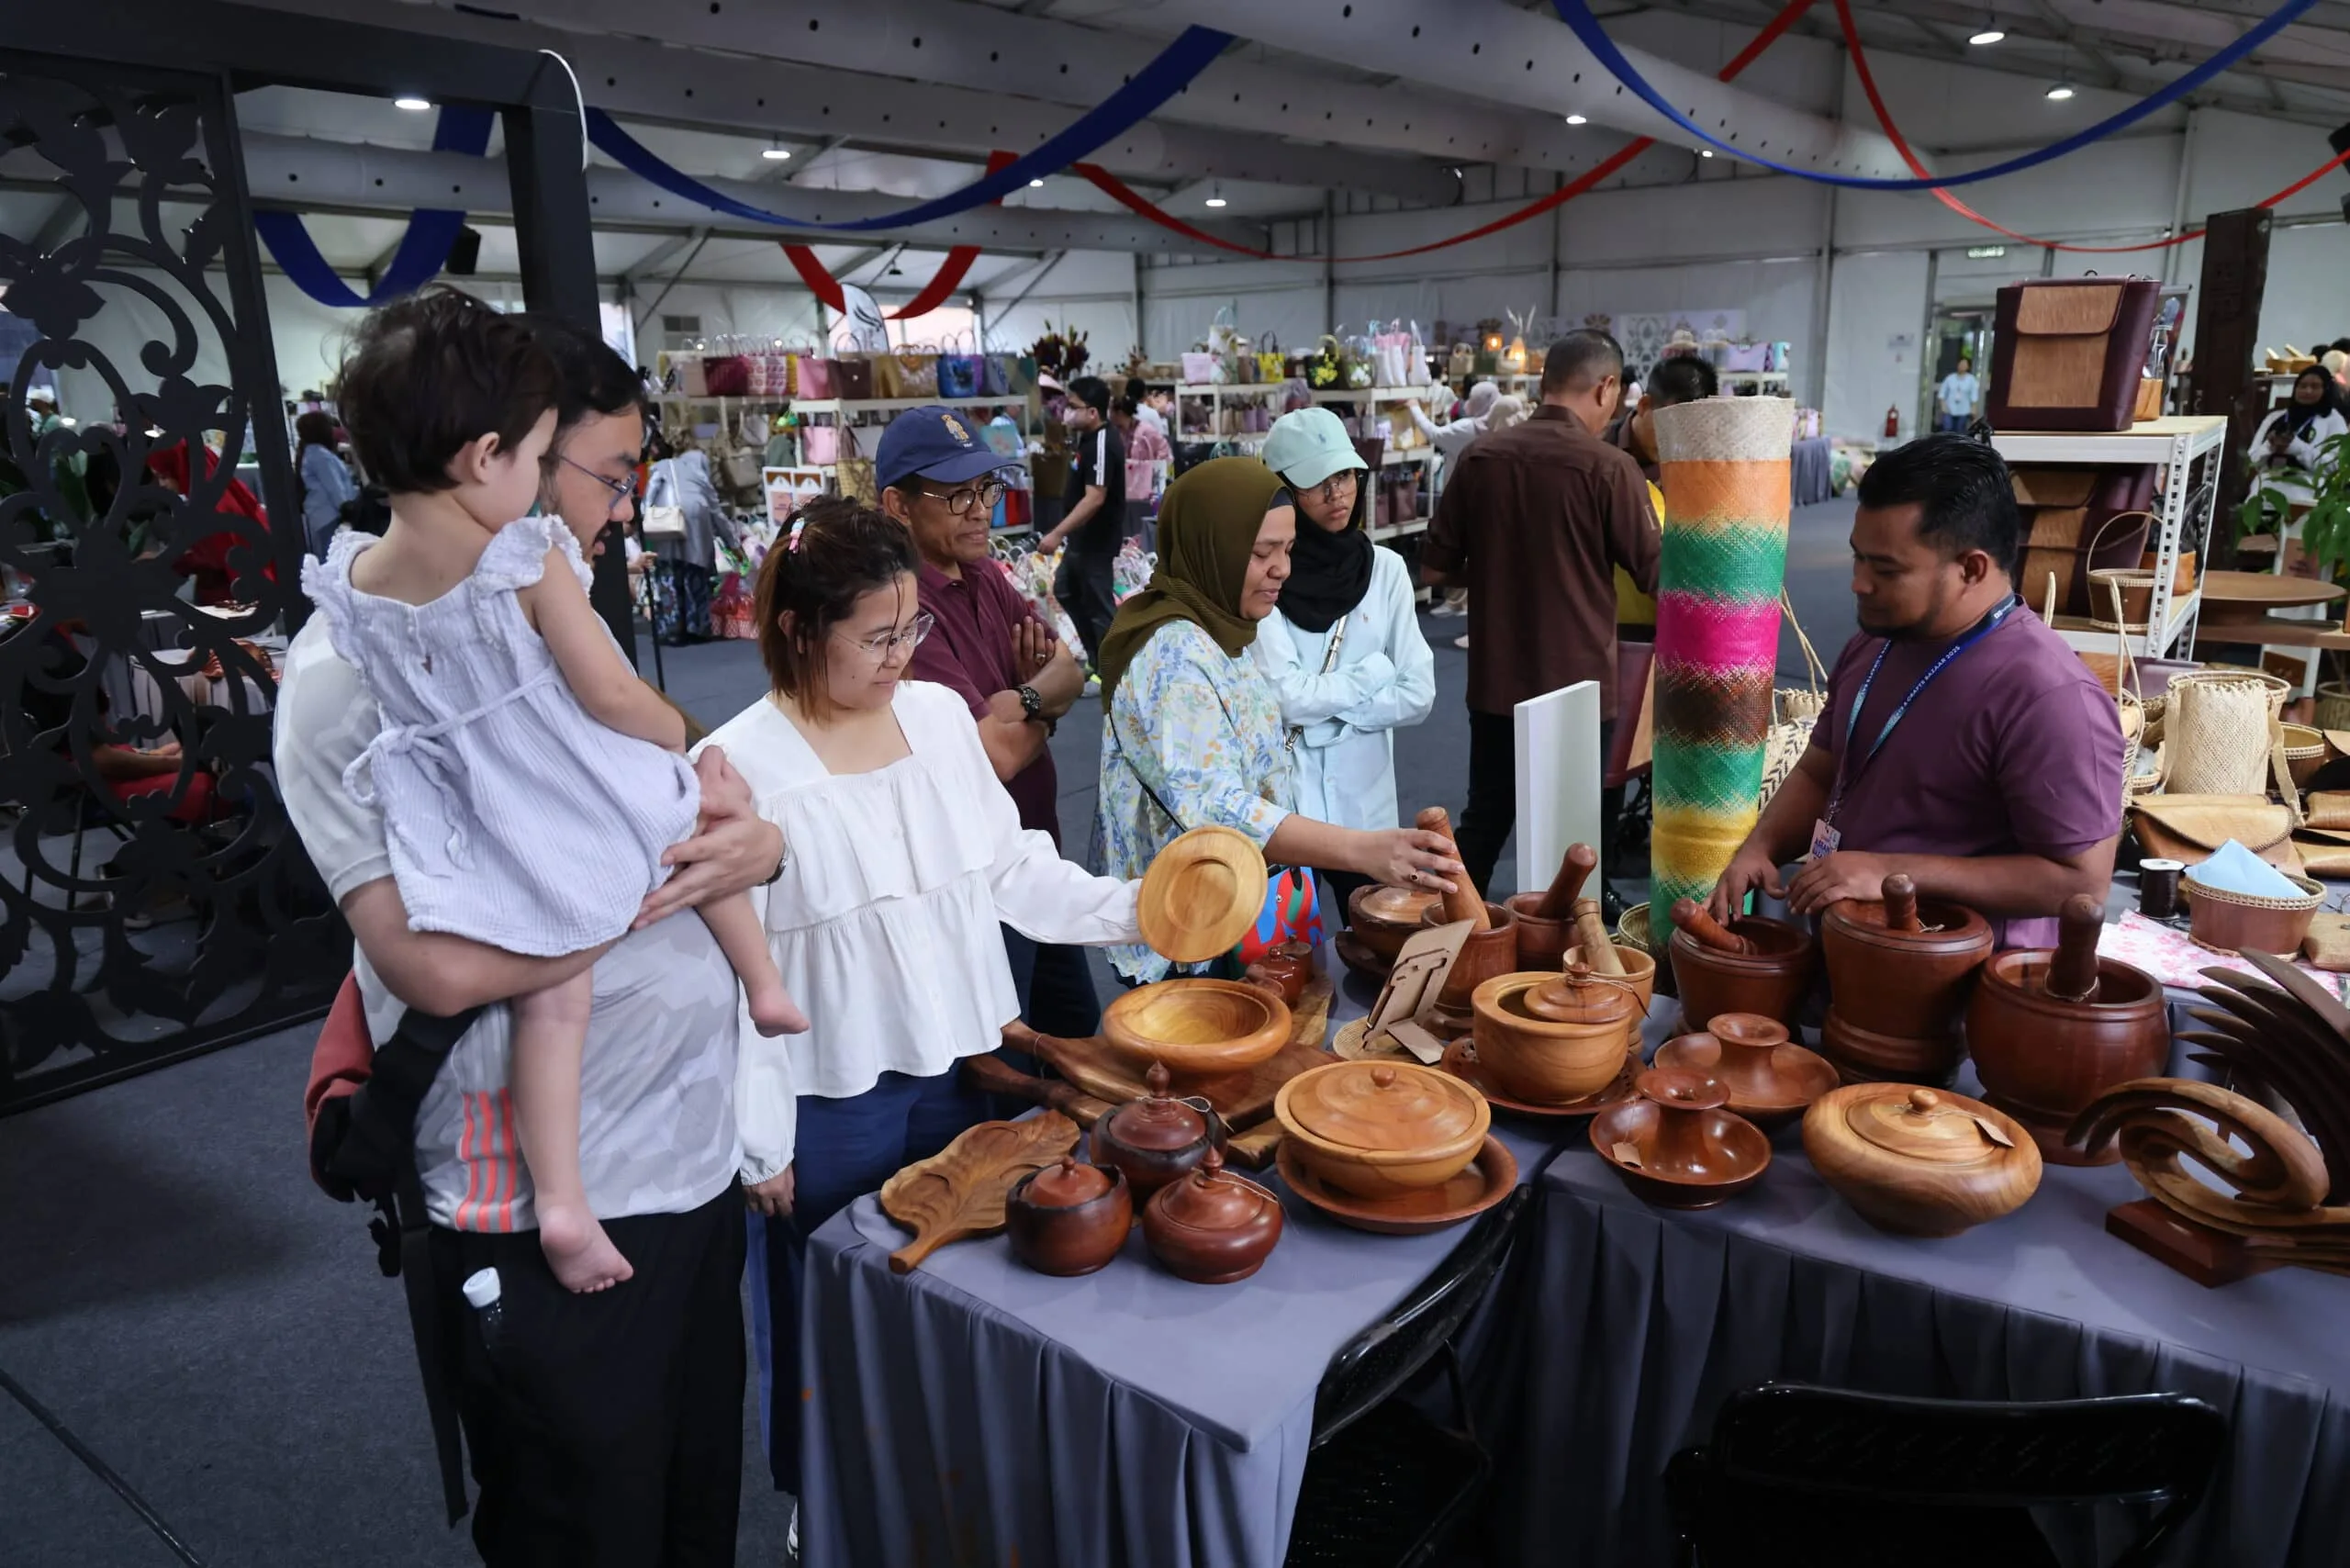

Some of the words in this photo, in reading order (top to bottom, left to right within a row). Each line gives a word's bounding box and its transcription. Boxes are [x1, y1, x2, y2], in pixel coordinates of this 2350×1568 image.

[1907, 679, 1926, 702] CRAFTS
[1924, 657, 1946, 680] BAZAAR
[1945, 645, 1961, 659] 2025
